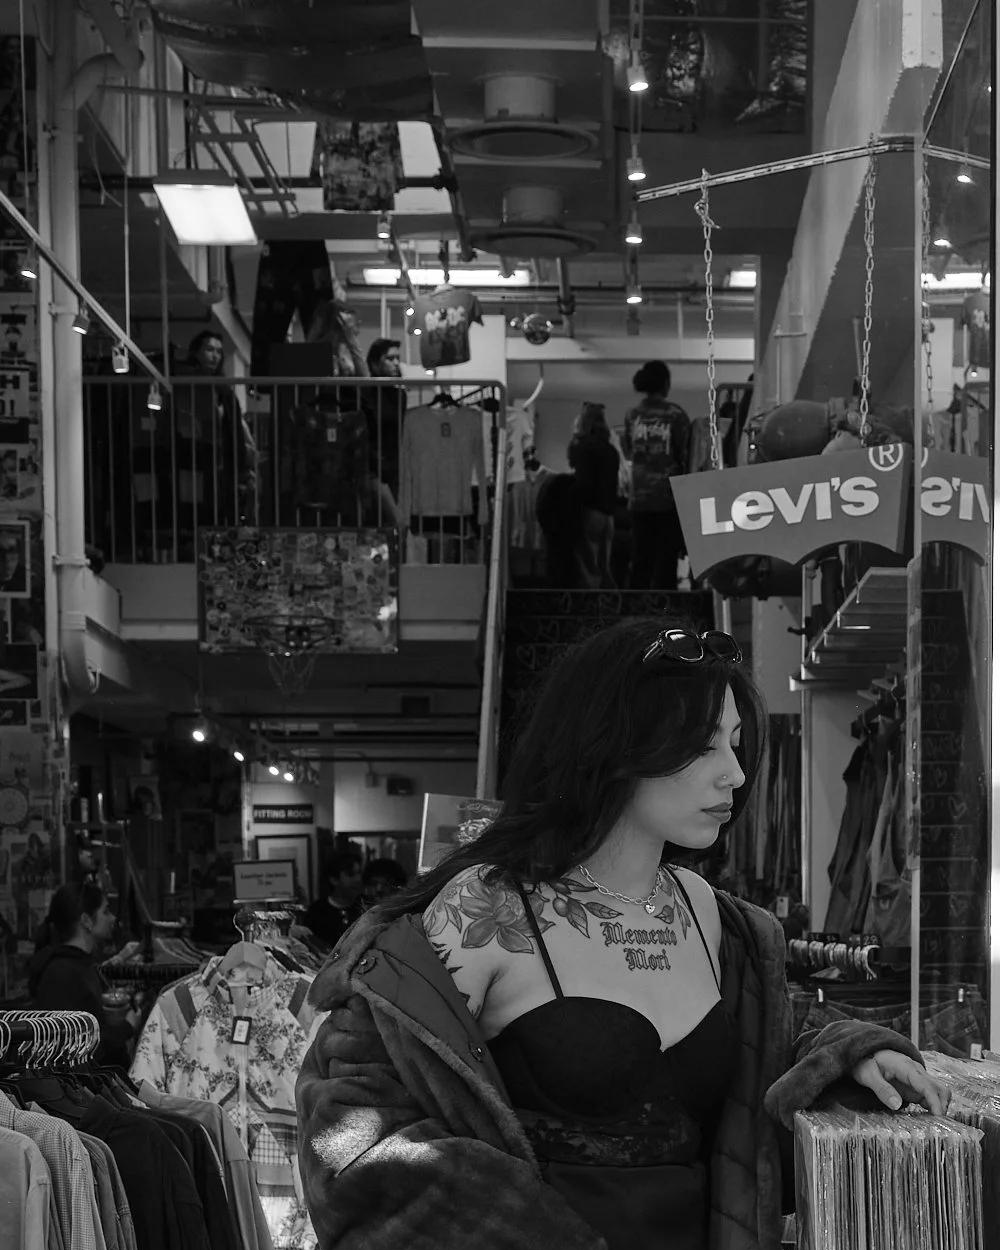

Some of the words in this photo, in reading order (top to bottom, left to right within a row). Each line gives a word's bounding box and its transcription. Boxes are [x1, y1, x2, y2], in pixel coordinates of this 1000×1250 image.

[254, 809, 286, 819] FITTING
[600, 921, 677, 946] Memento
[623, 948, 671, 971] Mori
